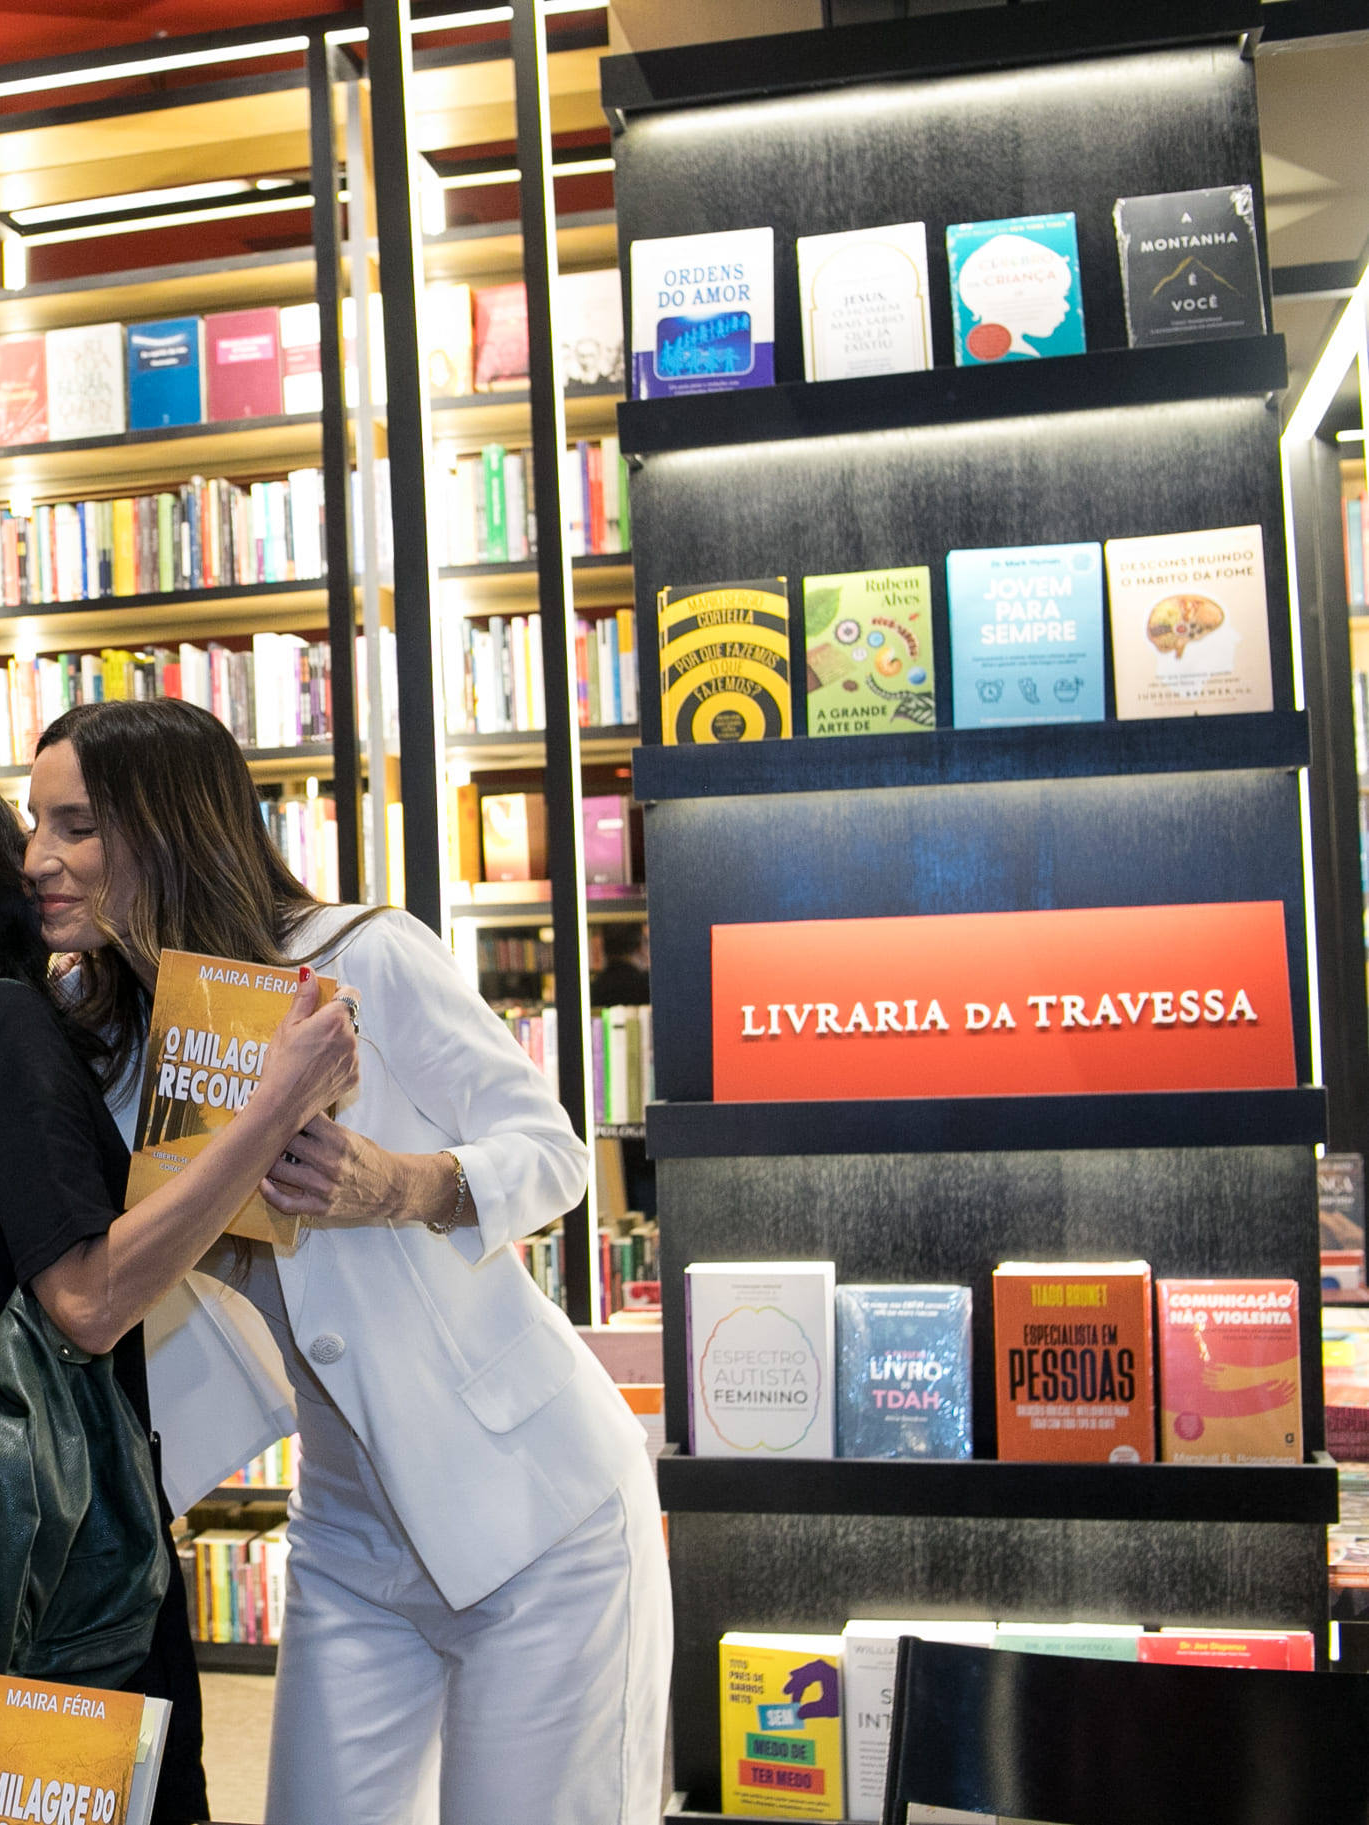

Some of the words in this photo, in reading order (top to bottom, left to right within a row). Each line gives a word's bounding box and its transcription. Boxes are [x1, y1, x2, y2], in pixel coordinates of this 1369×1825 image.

[1181, 211, 1192, 224] A
[1140, 231, 1239, 253] MONTANHA
[663, 263, 744, 287] ORDENS
[984, 271, 1056, 287] CRIANÇA
[657, 289, 685, 308] DO
[692, 284, 751, 306] AMOR
[1171, 294, 1219, 312] VOCÊ
[1120, 550, 1254, 572] DESCONSTRUINDO
[1193, 571, 1211, 581] DA
[1216, 567, 1255, 580] FOME
[865, 577, 920, 593] Rubem
[982, 575, 1072, 600] JOVEM
[881, 592, 920, 607] Alves
[696, 608, 754, 629] CORTELLA
[995, 599, 1061, 622] PARA
[980, 620, 1077, 645] SEMPRE
[673, 652, 701, 675] POR
[700, 643, 724, 659] QUE
[725, 642, 781, 669] FAZEMOS
[720, 659, 743, 675] QUE
[693, 676, 762, 702] FAZEMOS?
[817, 709, 826, 721] A
[830, 705, 888, 720] GRANDE
[817, 721, 850, 734] ARTE
[854, 719, 871, 731] DE
[199, 965, 250, 988] MAIRA
[254, 974, 298, 995] FÉRIA
[741, 999, 949, 1037] LIVRARIA
[964, 1002, 1017, 1030] DA
[1027, 989, 1258, 1029] TRAVESSA
[165, 1026, 181, 1055] O
[182, 1028, 269, 1077] MILAG
[158, 1063, 260, 1111] RECOM
[1169, 1292, 1292, 1311] COMUNICAÇÃO
[1169, 1310, 1208, 1325] NÃO
[1212, 1311, 1292, 1325] VIOLENTA
[1023, 1324, 1098, 1346] ESPECIALISTA
[1101, 1324, 1118, 1345] EM
[712, 1350, 808, 1366] ESPECTRO
[713, 1368, 808, 1387] AUTISTA
[870, 1360, 943, 1382] LIVRO
[1008, 1348, 1136, 1403] PESSOAS
[713, 1389, 809, 1405] FEMININO
[872, 1389, 941, 1410] TDAH
[853, 1644, 898, 1655] WILLIA
[1209, 1640, 1247, 1653] Dispenza
[6, 1688, 58, 1713] MAIRA
[62, 1693, 107, 1720] FÉRIA
[881, 1688, 893, 1705] S
[765, 1708, 796, 1728] SEM
[858, 1712, 892, 1729] INT
[753, 1739, 790, 1760] MEDO
[790, 1742, 808, 1760] DE
[751, 1766, 774, 1784] TER
[776, 1770, 812, 1789] MEDO
[91, 1787, 117, 1825] DO
